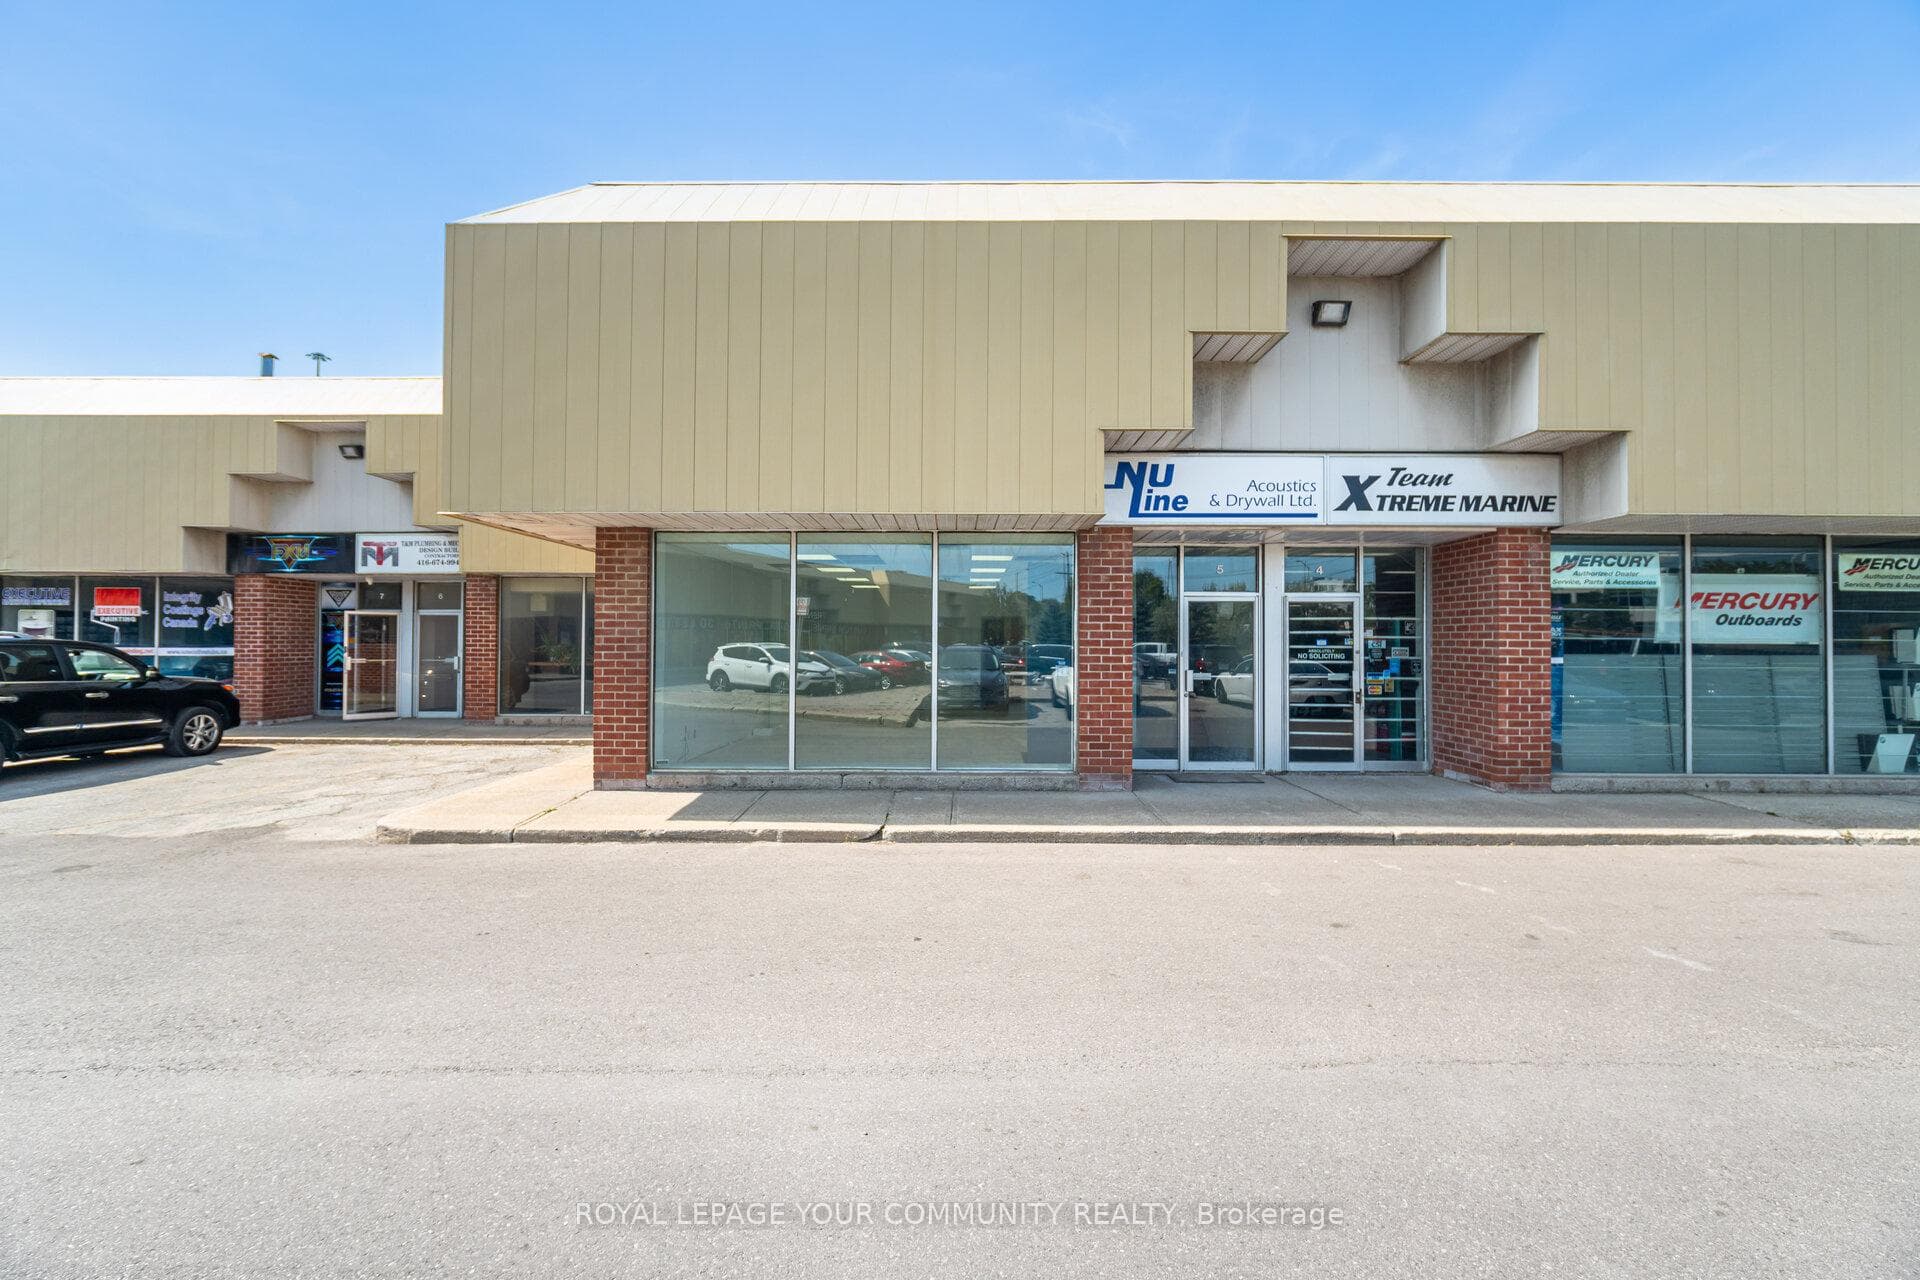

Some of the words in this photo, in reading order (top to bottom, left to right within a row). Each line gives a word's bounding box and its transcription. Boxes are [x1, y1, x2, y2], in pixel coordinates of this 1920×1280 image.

[1386, 467, 1453, 486] Team
[1246, 480, 1317, 492] Acoustics
[1209, 494, 1220, 507] &
[1226, 494, 1284, 510] Drywall
[1290, 494, 1317, 507] Ltd.
[1459, 495, 1557, 512] MARINE
[1561, 555, 1655, 568] MERCURY
[1216, 565, 1224, 574] 5
[1315, 565, 1323, 574] 4
[1674, 592, 1819, 610] MERCURY
[1715, 613, 1803, 627] Outboards
